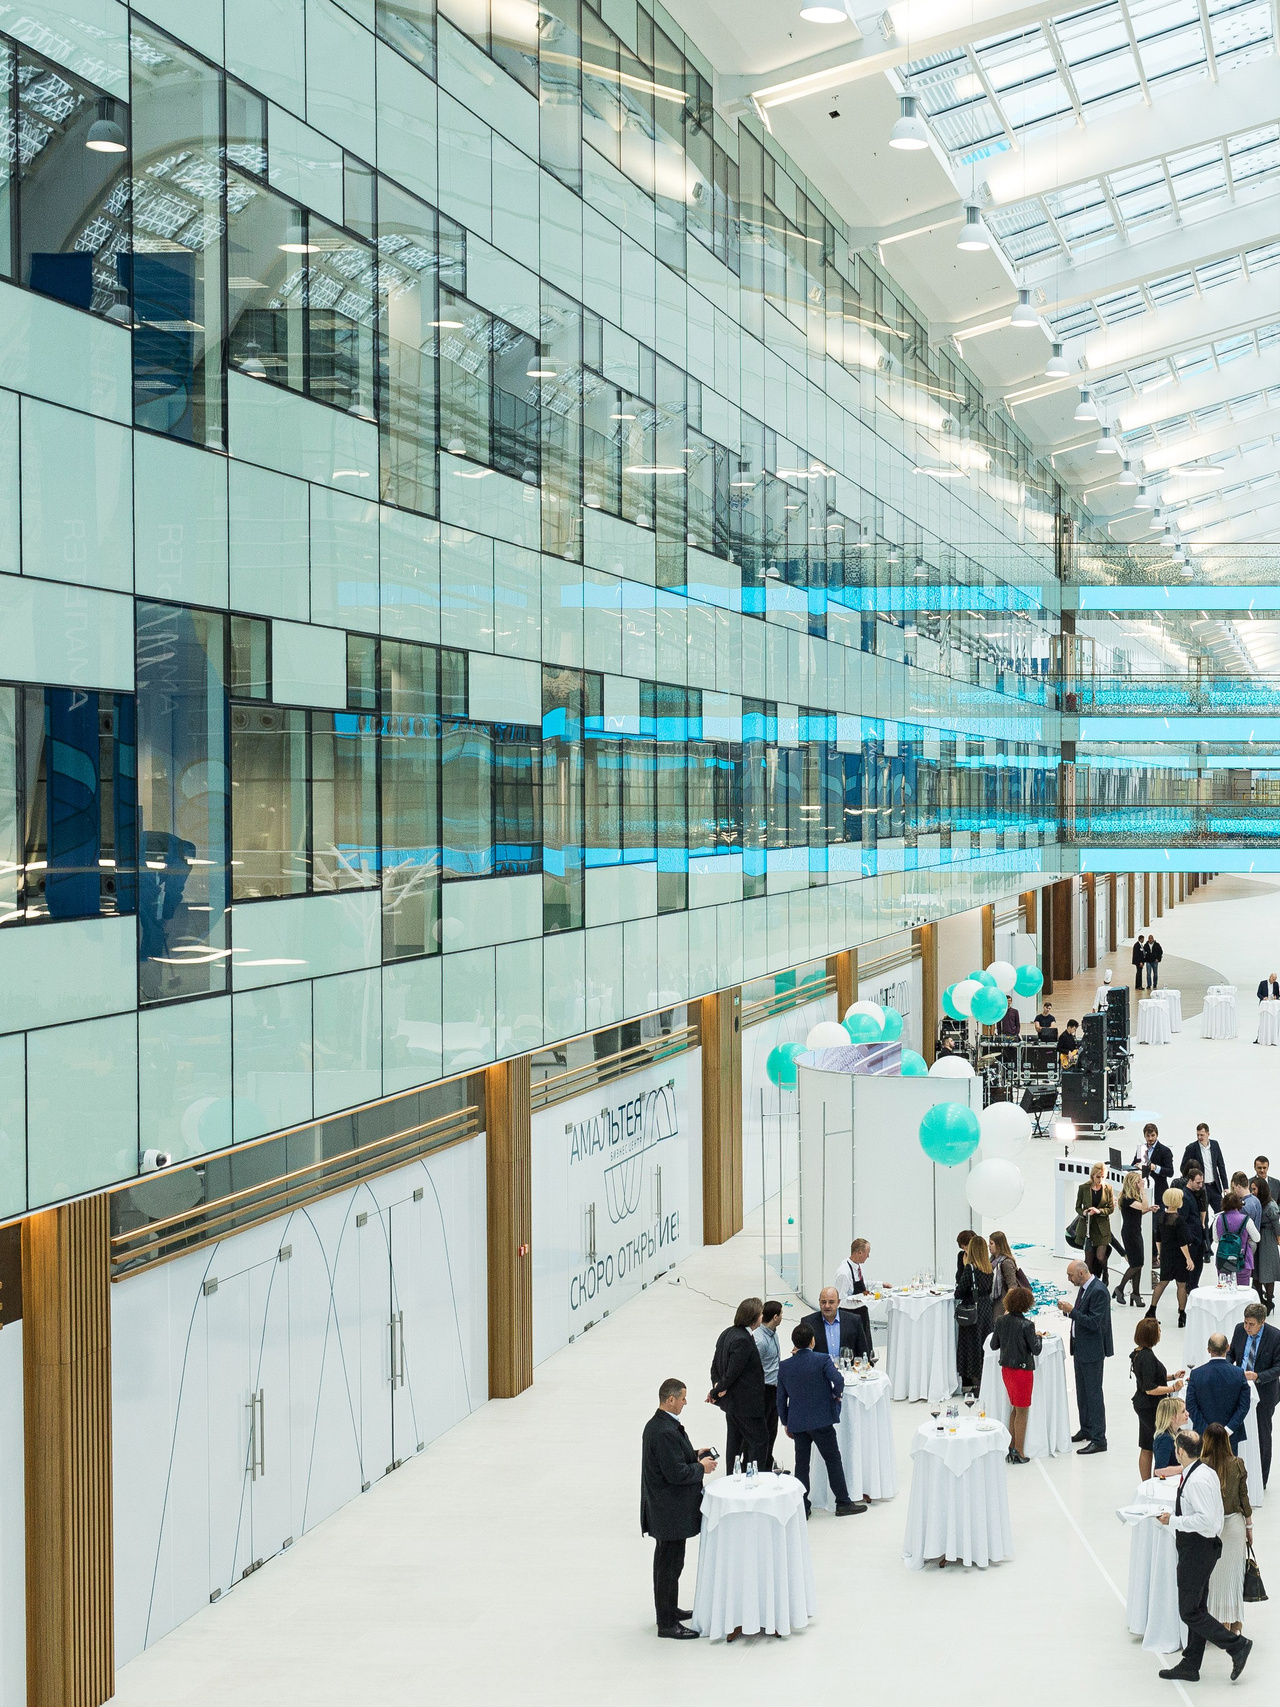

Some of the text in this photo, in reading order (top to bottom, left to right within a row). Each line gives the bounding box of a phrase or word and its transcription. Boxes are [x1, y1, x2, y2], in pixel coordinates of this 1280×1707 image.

[570, 1097, 642, 1165] АМАЛЬТЕЯ
[570, 1210, 680, 1311] СКОРО ОТКРЫИЕ!
